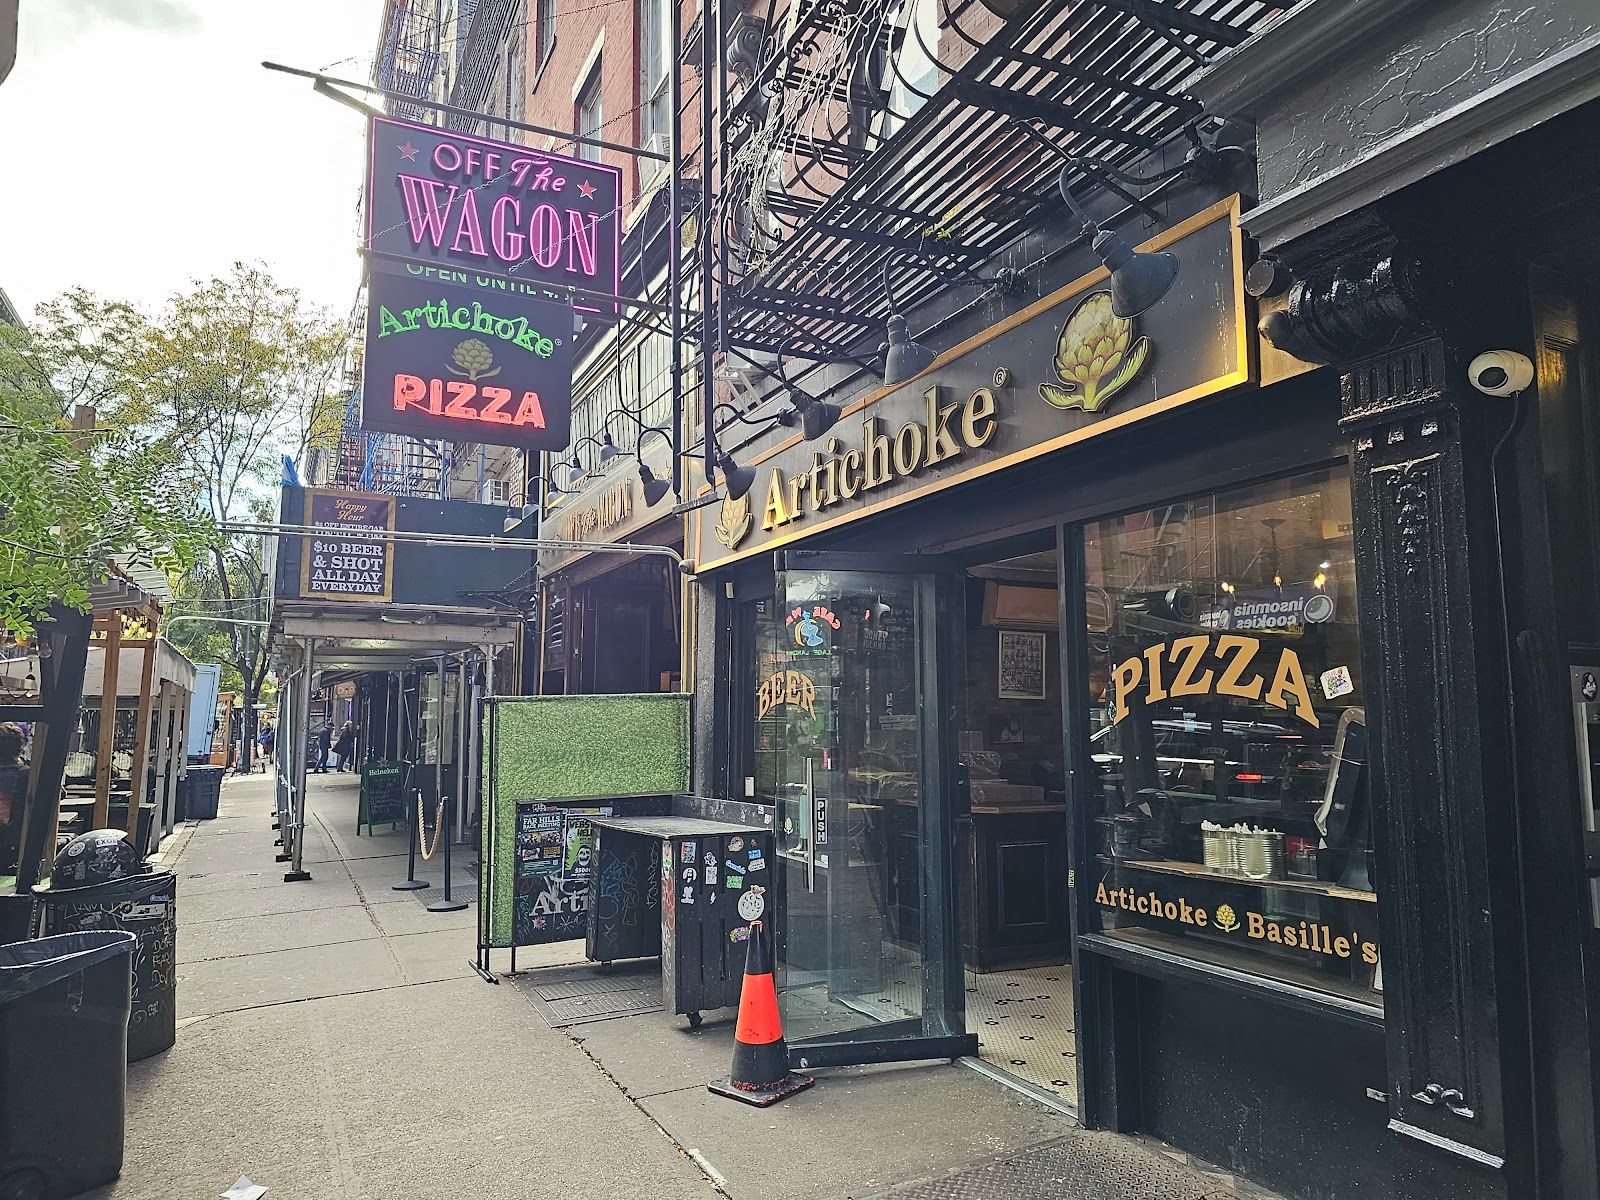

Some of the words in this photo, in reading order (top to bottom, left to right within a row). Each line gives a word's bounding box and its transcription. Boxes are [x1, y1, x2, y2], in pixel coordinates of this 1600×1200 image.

[434, 143, 501, 181] OFF
[511, 157, 566, 192] The
[397, 174, 600, 276] WAGON
[393, 373, 546, 429] PIZZA
[334, 499, 368, 512] Happy
[337, 510, 364, 521] Hour
[313, 540, 338, 554] $10
[341, 543, 384, 557] BEER
[313, 555, 327, 568] &
[331, 556, 383, 571] SHOT
[311, 581, 382, 594] EVERYDAY
[312, 569, 346, 582] ALL
[349, 571, 382, 583] DAY
[758, 669, 816, 721] BEER
[1111, 635, 1321, 730] PIZZA
[369, 767, 400, 776] Heineken
[816, 800, 827, 843] PUSH
[1094, 882, 1208, 927] Artichoke
[1246, 911, 1379, 964] Basille's
